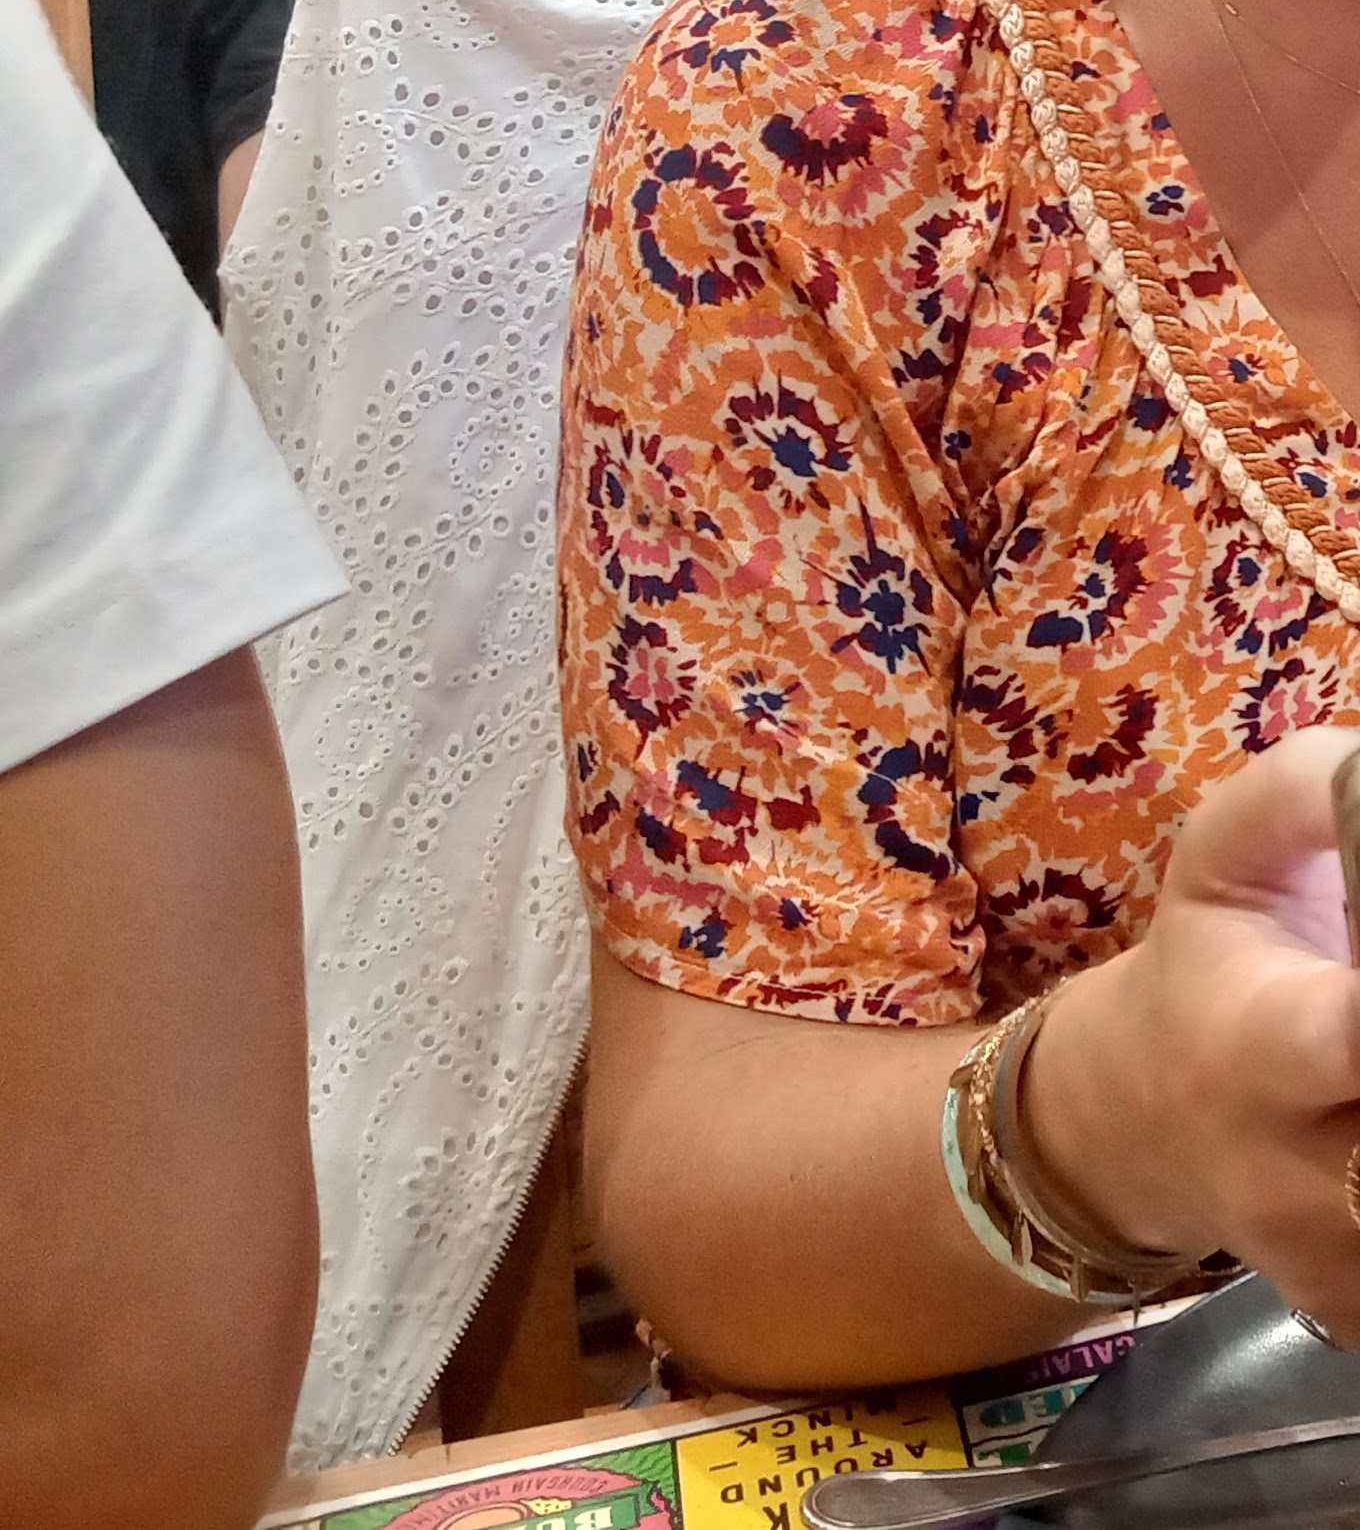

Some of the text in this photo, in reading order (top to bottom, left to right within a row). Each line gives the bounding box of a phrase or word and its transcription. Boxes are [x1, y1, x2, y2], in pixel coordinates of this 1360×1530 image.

[736, 1397, 898, 1448] MINCK
[776, 1428, 870, 1466] THE
[719, 1438, 929, 1505] AROUND
